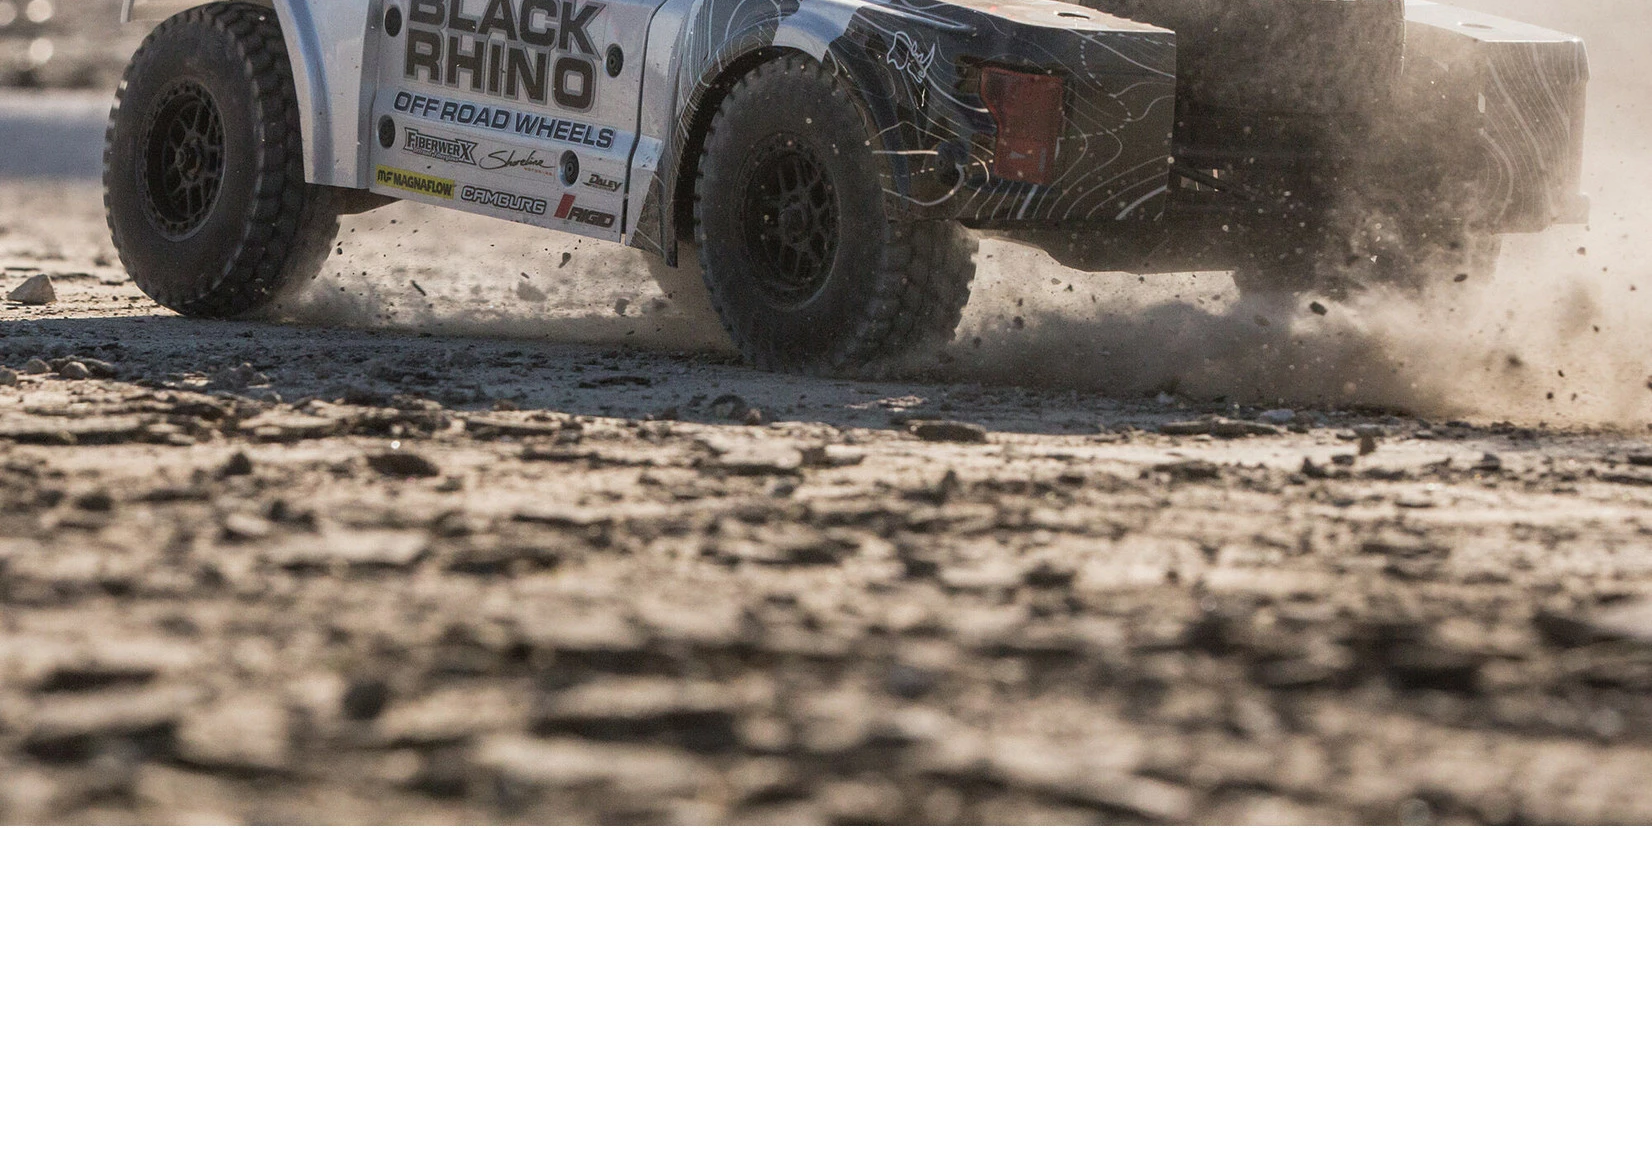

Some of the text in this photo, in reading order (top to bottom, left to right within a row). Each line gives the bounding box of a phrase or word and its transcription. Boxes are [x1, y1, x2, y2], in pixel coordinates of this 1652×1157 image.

[404, 29, 597, 113] RHINO
[393, 91, 616, 148] OFF ROAD WHEELS
[479, 150, 555, 170] Shoreline
[393, 172, 454, 197] MAGNAFLOW
[461, 185, 547, 215] CAMBURG
